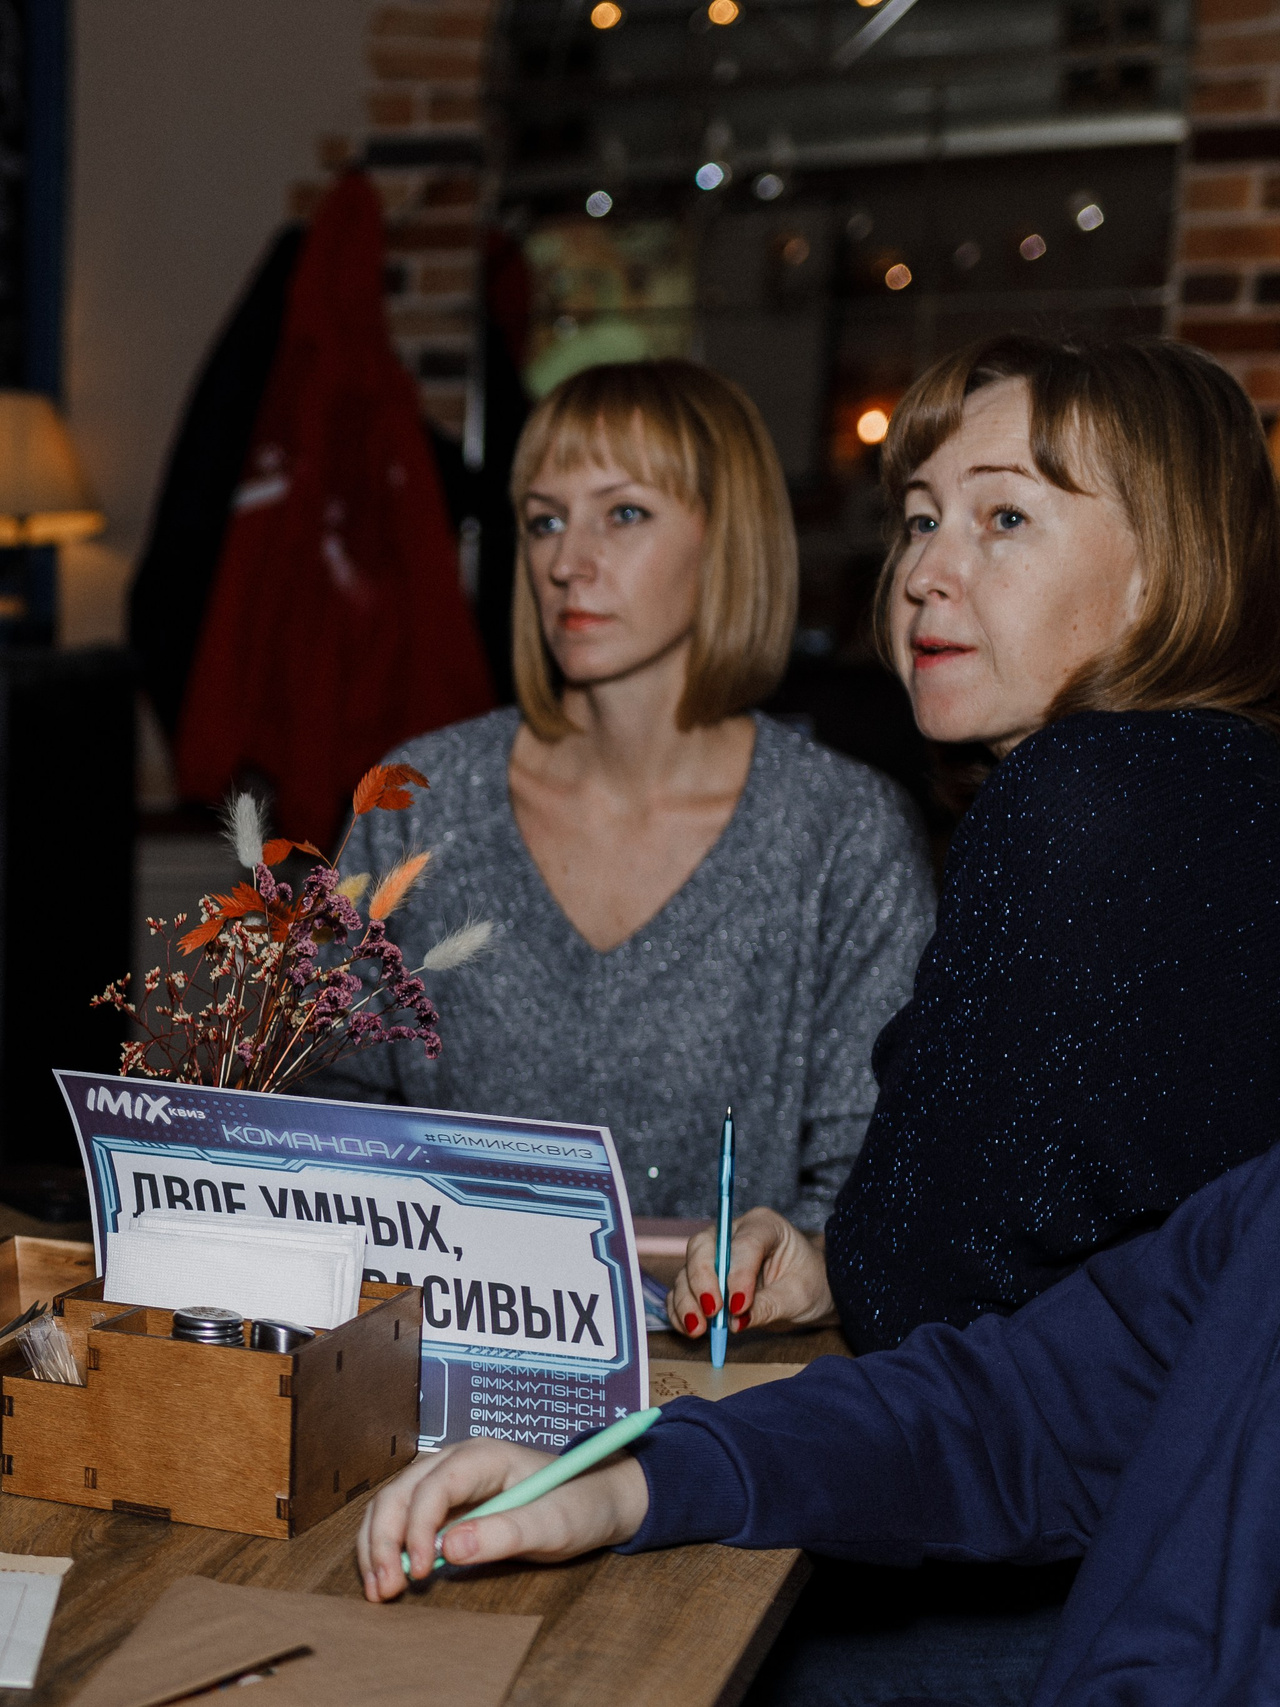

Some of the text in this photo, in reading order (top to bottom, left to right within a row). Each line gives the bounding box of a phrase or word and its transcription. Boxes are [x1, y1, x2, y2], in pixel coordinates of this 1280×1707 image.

[86, 1085, 172, 1125] IMIX
[424, 1131, 594, 1160] #АЙМИКСКВИЗ
[132, 1171, 464, 1262] ДВОЕ УМНЫХ,
[363, 1268, 605, 1347] СИВЫХ
[470, 1375, 606, 1401] @IMIX.MYTISHCHI
[470, 1391, 606, 1418] @IMIX.MYTISHCHI
